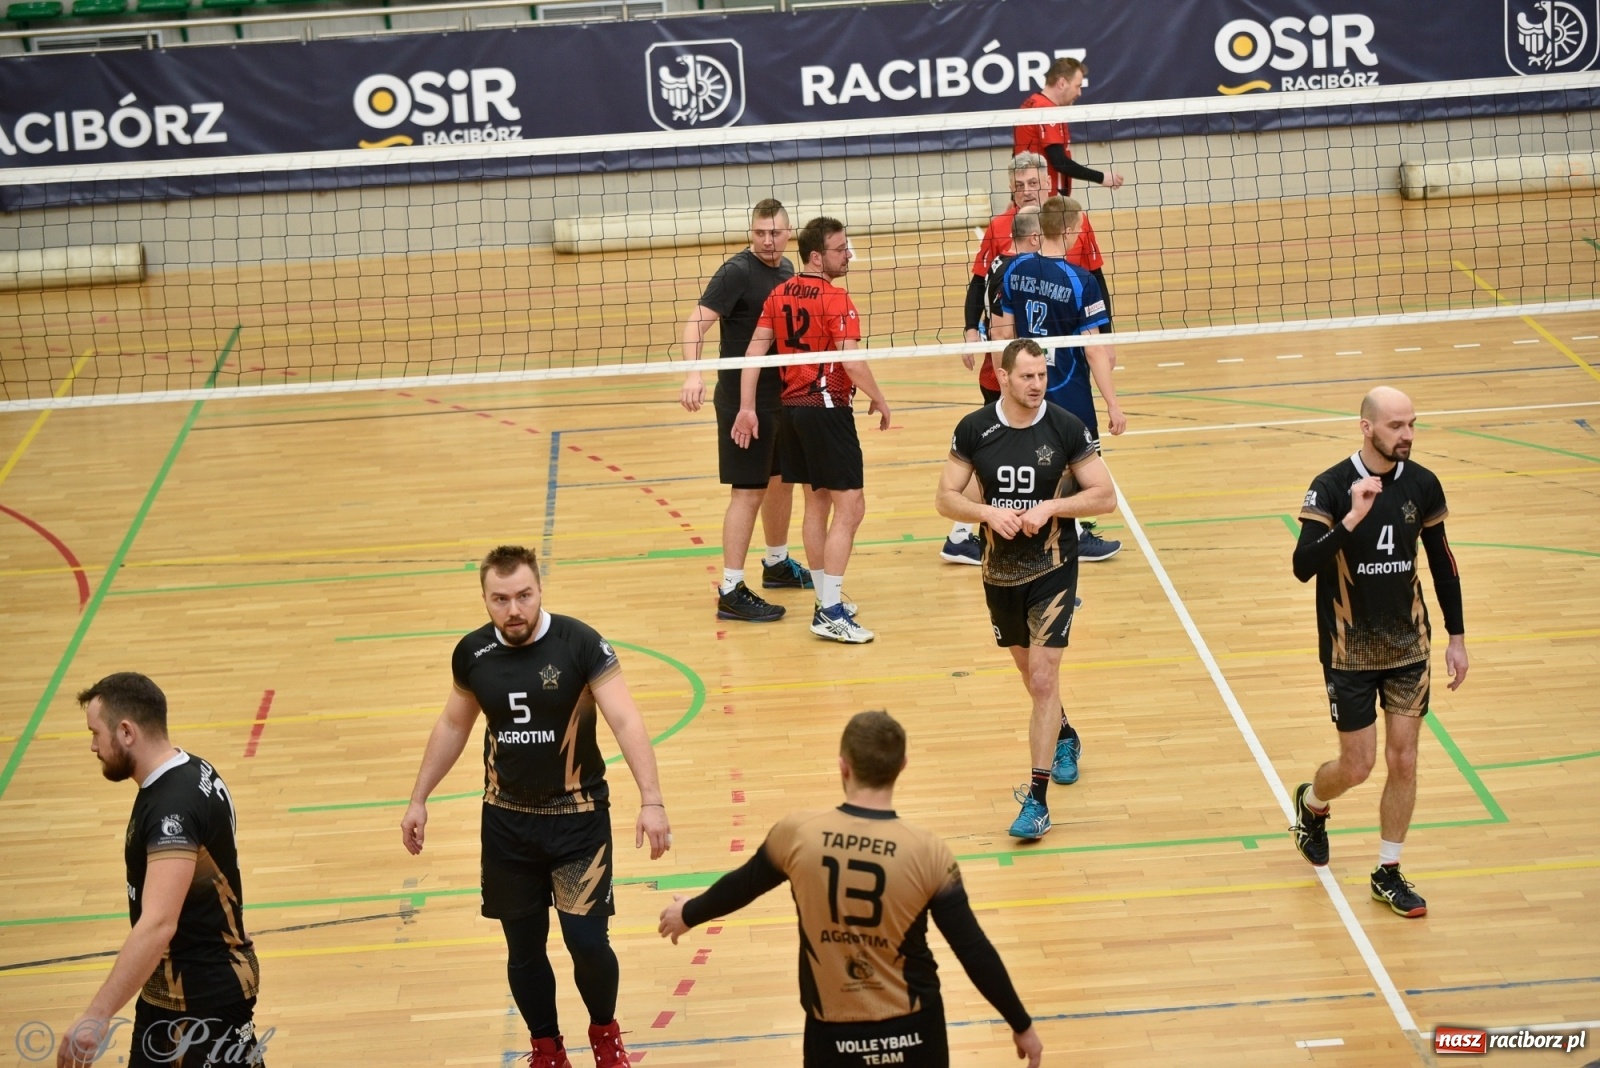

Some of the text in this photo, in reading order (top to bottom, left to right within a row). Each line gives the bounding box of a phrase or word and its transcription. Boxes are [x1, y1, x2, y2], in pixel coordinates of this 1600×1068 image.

[1214, 14, 1379, 74] OSiR
[1281, 69, 1380, 92] RACIBÓRZ
[352, 67, 522, 129] OSiR
[422, 123, 524, 146] RACIBÓRZ
[781, 303, 811, 351] 12
[1025, 299, 1048, 336] 12
[997, 465, 1036, 494] 99
[1376, 524, 1395, 555] 4
[1357, 560, 1412, 575] AGROTIM
[508, 691, 532, 724] 5
[497, 729, 555, 744] AGROTIM
[822, 831, 897, 857] TAPPER
[822, 855, 886, 928] 13
[820, 930, 889, 949] AGROTIM
[836, 1033, 923, 1053] VOLLEYBALL
[863, 1052, 904, 1065] TEAM
